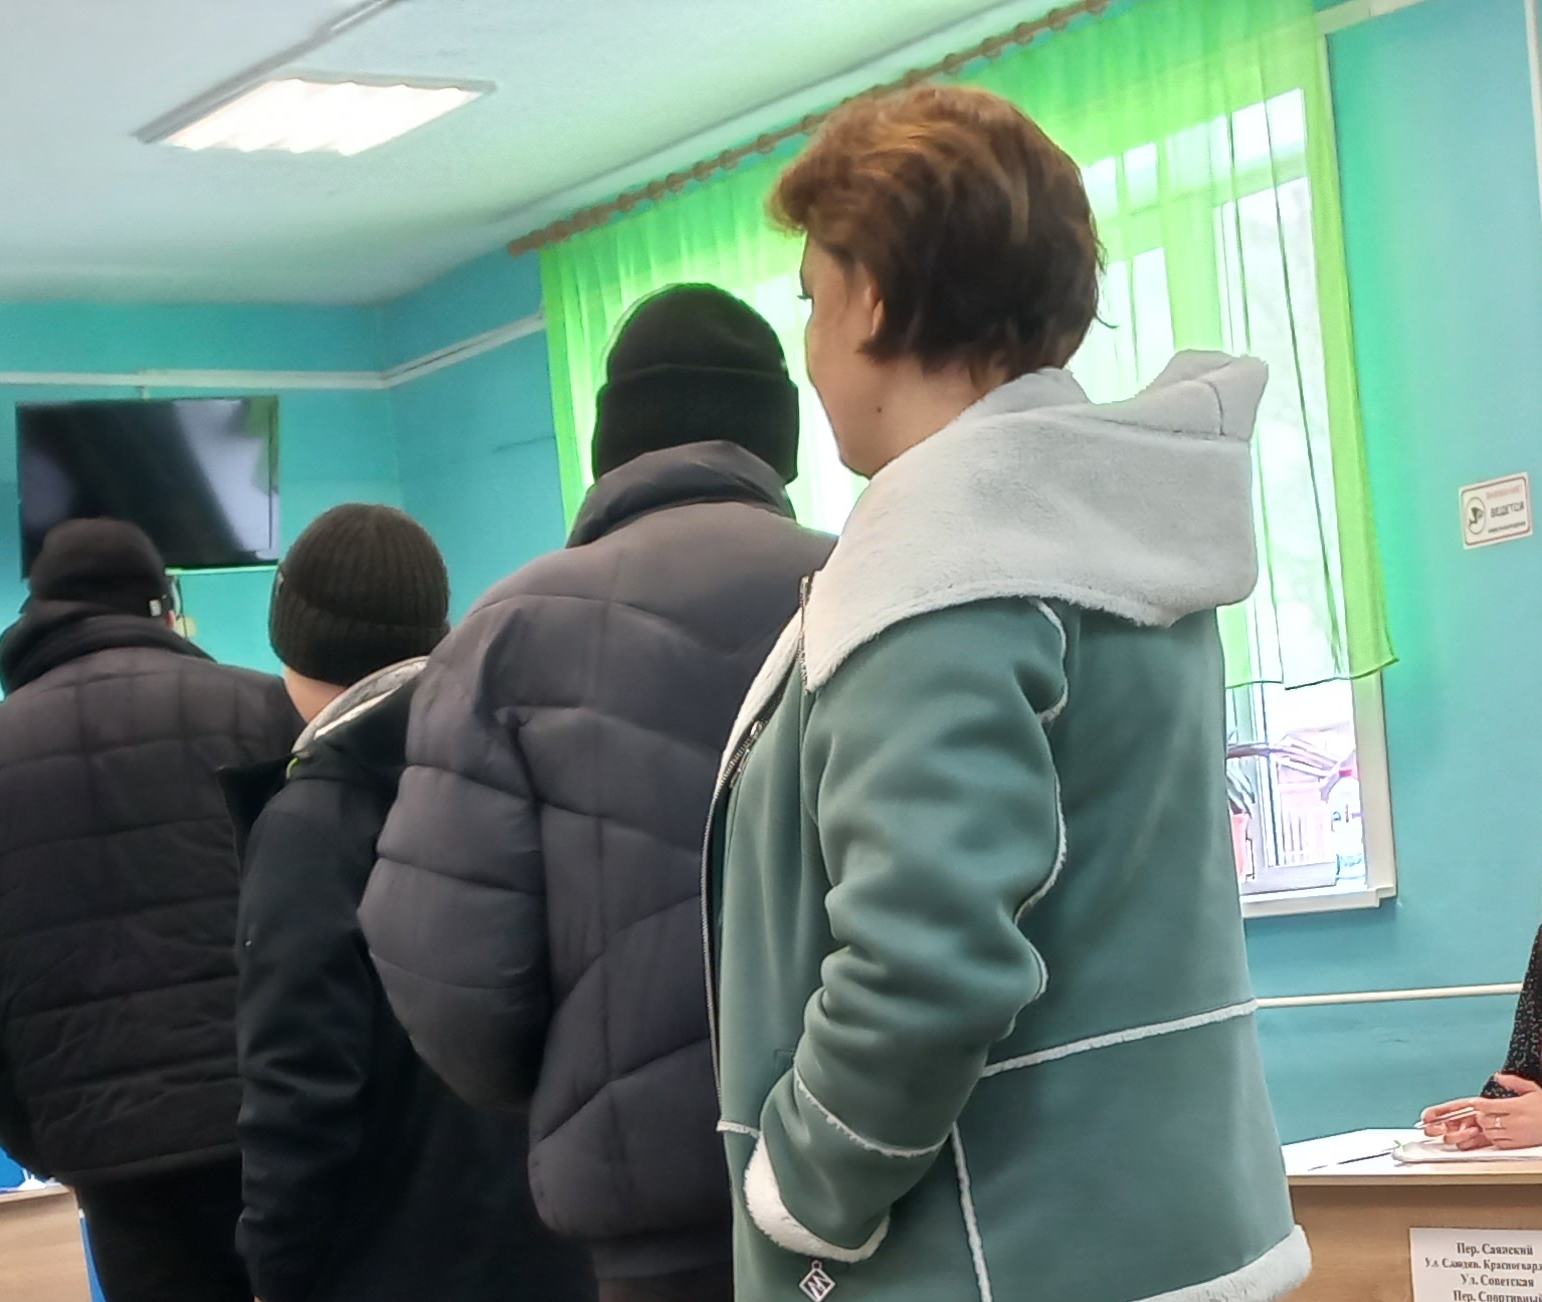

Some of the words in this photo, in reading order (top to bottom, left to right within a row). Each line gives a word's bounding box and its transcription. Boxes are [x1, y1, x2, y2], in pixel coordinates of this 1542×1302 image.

[1457, 1243, 1480, 1256] Пер.
[1482, 1243, 1533, 1256] Саянский
[1461, 1274, 1478, 1286] Ул.
[1480, 1274, 1534, 1287] Советская
[1453, 1290, 1476, 1302] Пер.
